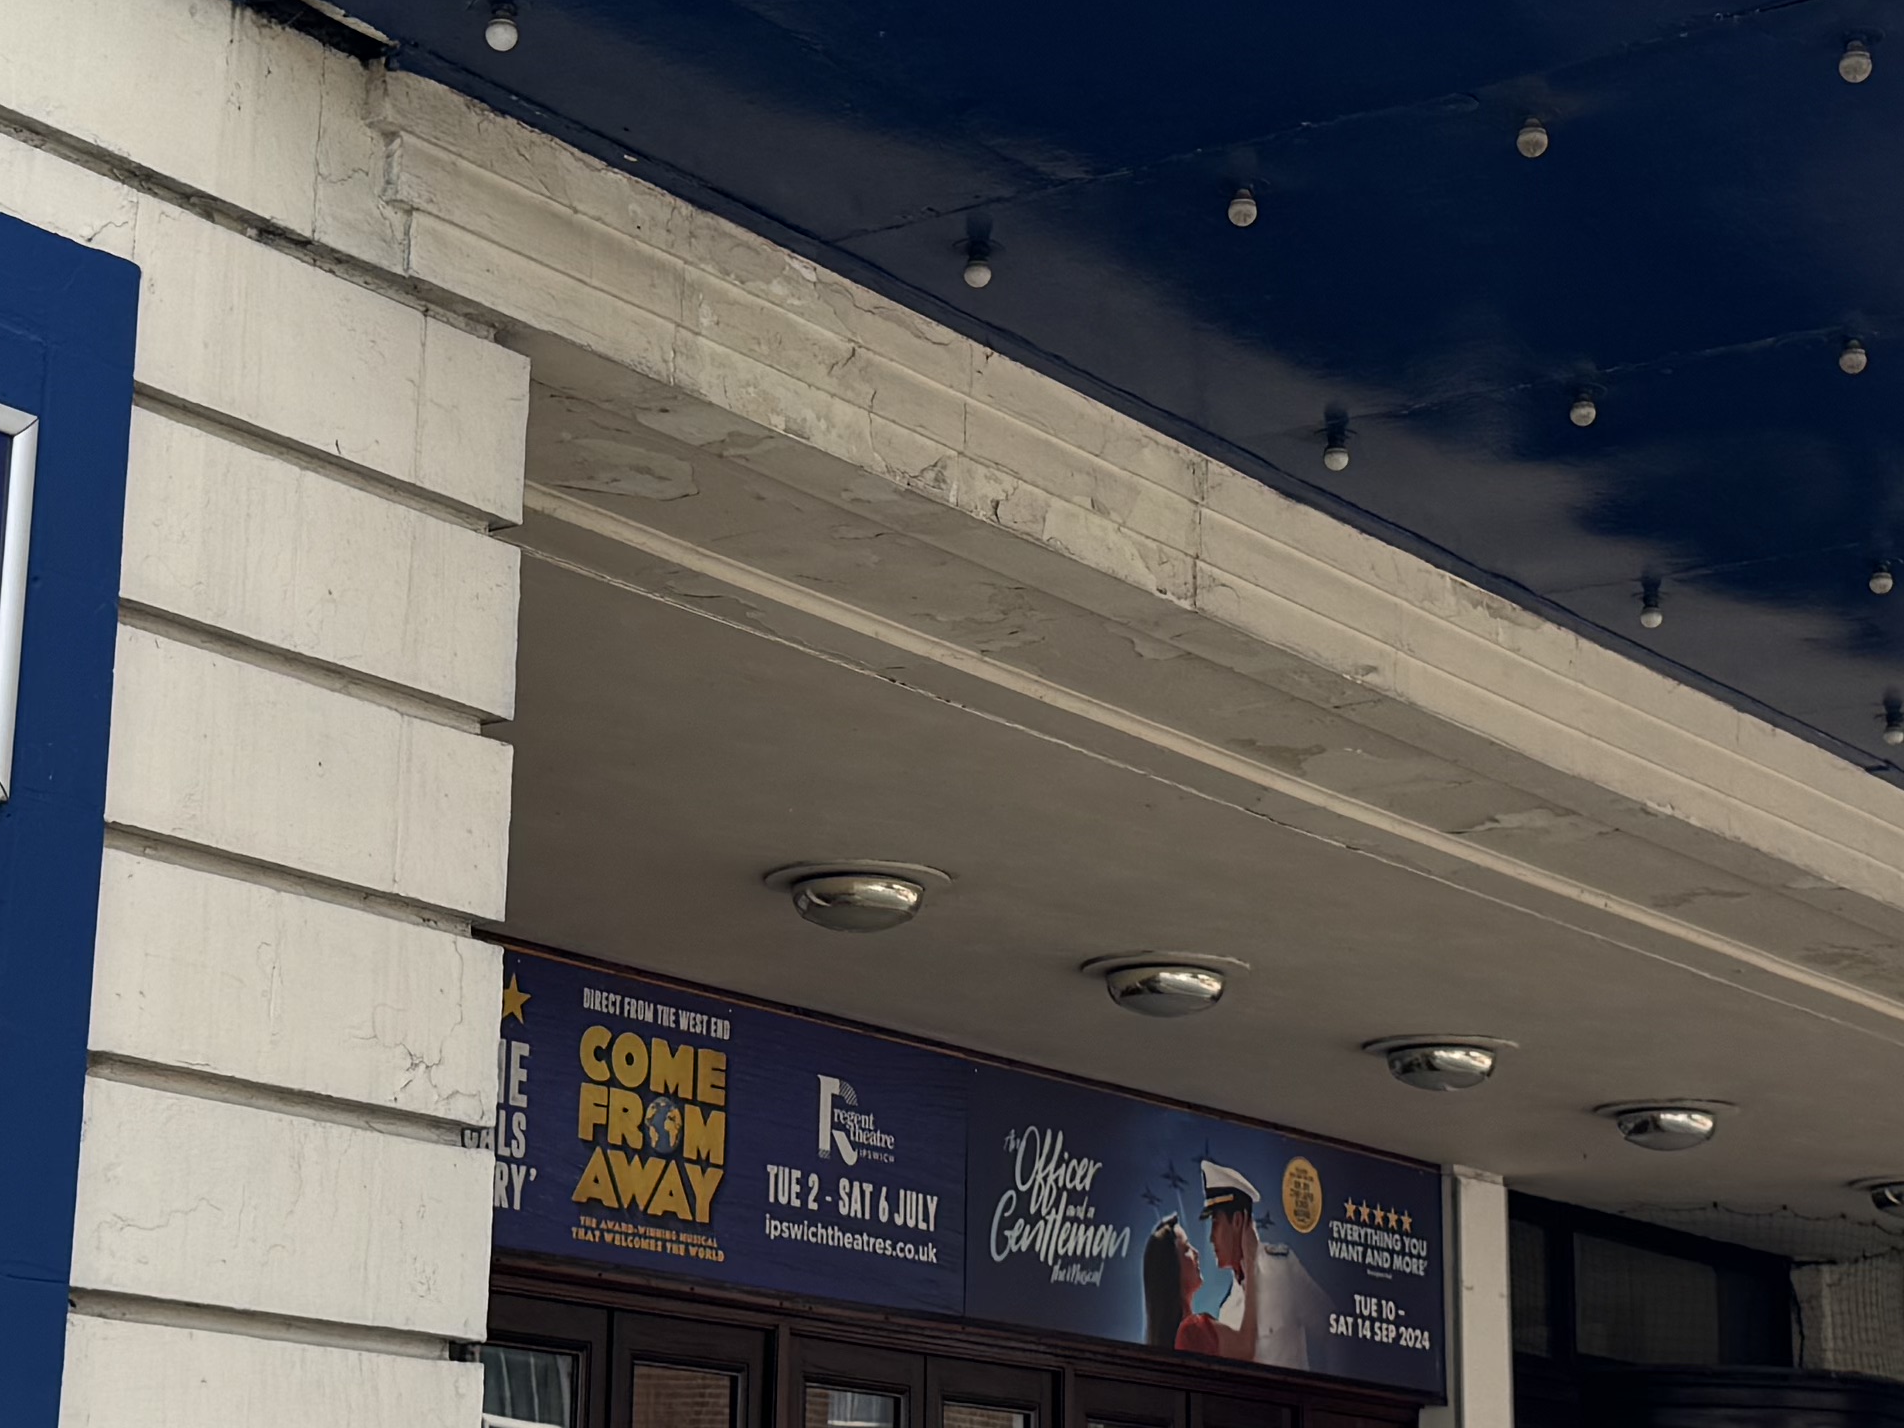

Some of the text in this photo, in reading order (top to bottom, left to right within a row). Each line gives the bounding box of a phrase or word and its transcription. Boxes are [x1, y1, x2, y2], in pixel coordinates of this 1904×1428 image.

[583, 987, 731, 1040] DIRECT FROM THE WEST END
[579, 1025, 727, 1106] COME
[833, 1107, 875, 1130] regent
[849, 1123, 895, 1149] theatre
[571, 1145, 724, 1223] AWAY
[1015, 1125, 1103, 1215] Officer
[767, 1164, 802, 1209] TUE
[807, 1172, 819, 1211] 2
[838, 1177, 873, 1220] SAT
[878, 1186, 889, 1223] 6
[894, 1188, 938, 1232] JULY
[571, 1226, 726, 1262] THAT WELCOMES THE WORLD
[765, 1214, 938, 1263] ipswichtheatres.co.uk
[990, 1189, 1131, 1266] Gentleman
[1403, 1236, 1428, 1258] YOU
[1328, 1240, 1363, 1264] WANT
[1365, 1250, 1391, 1269] AND
[1354, 1294, 1378, 1318] TUE
[1381, 1299, 1396, 1321] 10
[1329, 1313, 1430, 1350] SAT 14 SEP 2024
